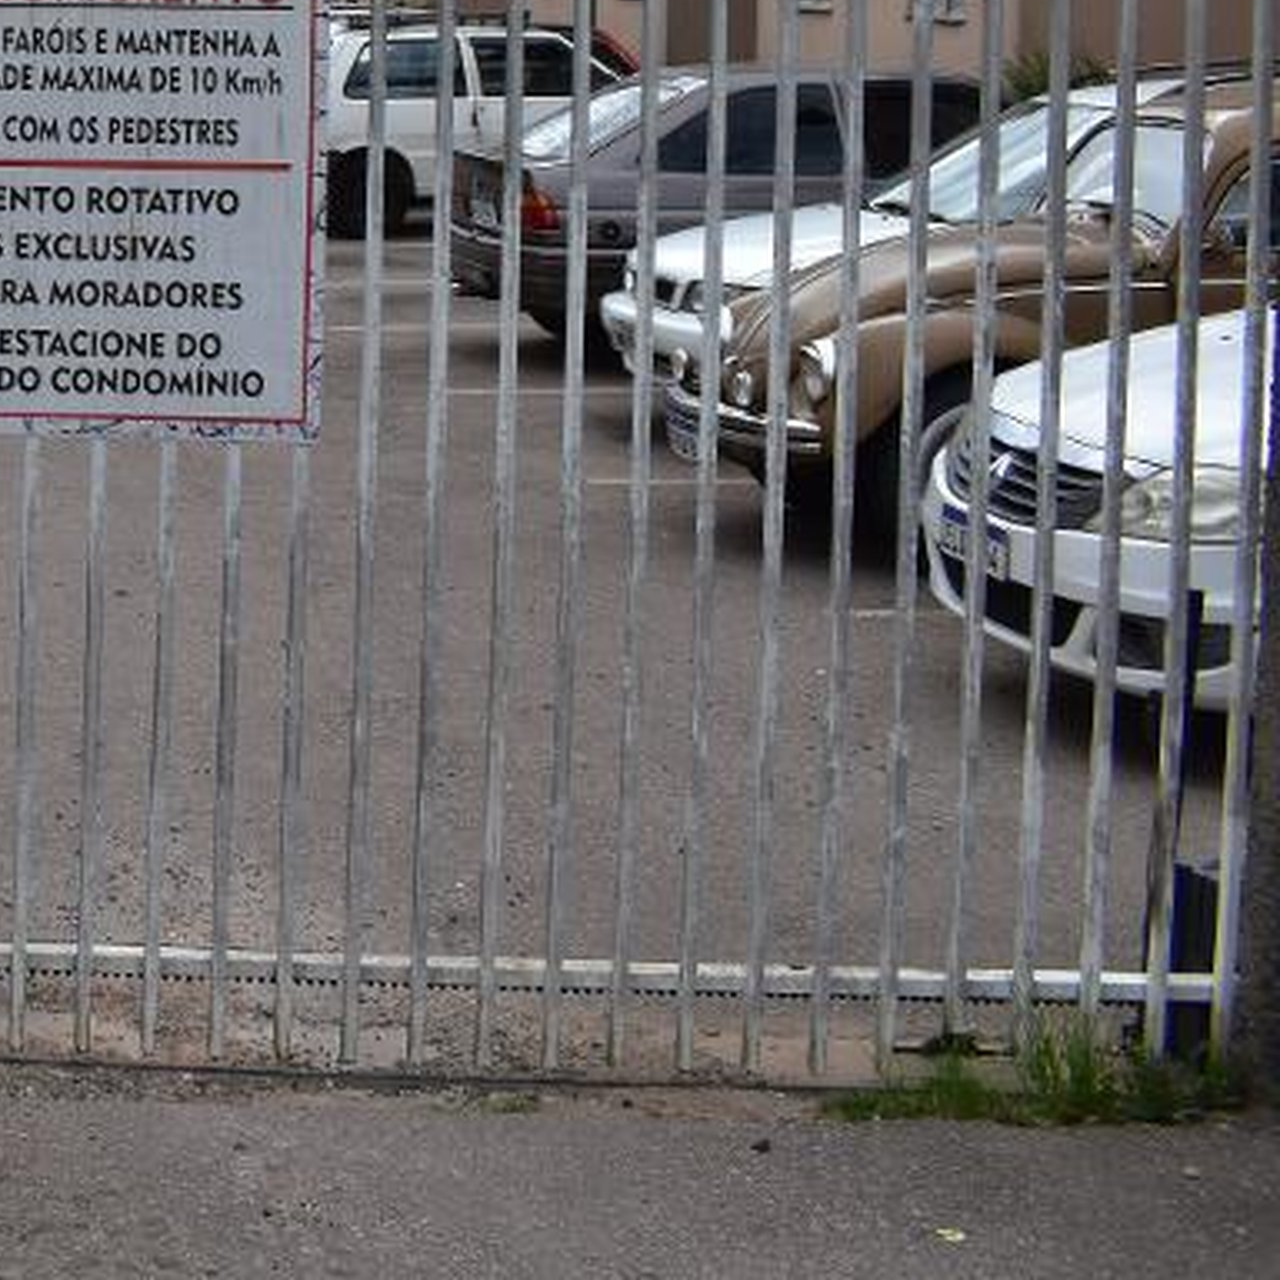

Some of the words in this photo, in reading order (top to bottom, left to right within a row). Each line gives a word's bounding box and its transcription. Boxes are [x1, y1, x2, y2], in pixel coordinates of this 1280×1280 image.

[2, 18, 88, 55] FARÓIS
[94, 27, 108, 55] E
[114, 28, 258, 58] MANTENHA
[261, 32, 282, 58] A
[149, 65, 182, 94] DE
[191, 66, 219, 95] 10
[224, 67, 283, 97] Km/h
[2, 114, 61, 144] COM
[66, 115, 100, 145] OS
[108, 116, 239, 148] PEDESTRES
[86, 185, 240, 217] ROTATIVO
[14, 232, 196, 264] EXCLUSIVAS
[48, 279, 244, 311] MORADORES
[176, 332, 223, 361] DO
[50, 361, 265, 398] CONDOMÍNIO
